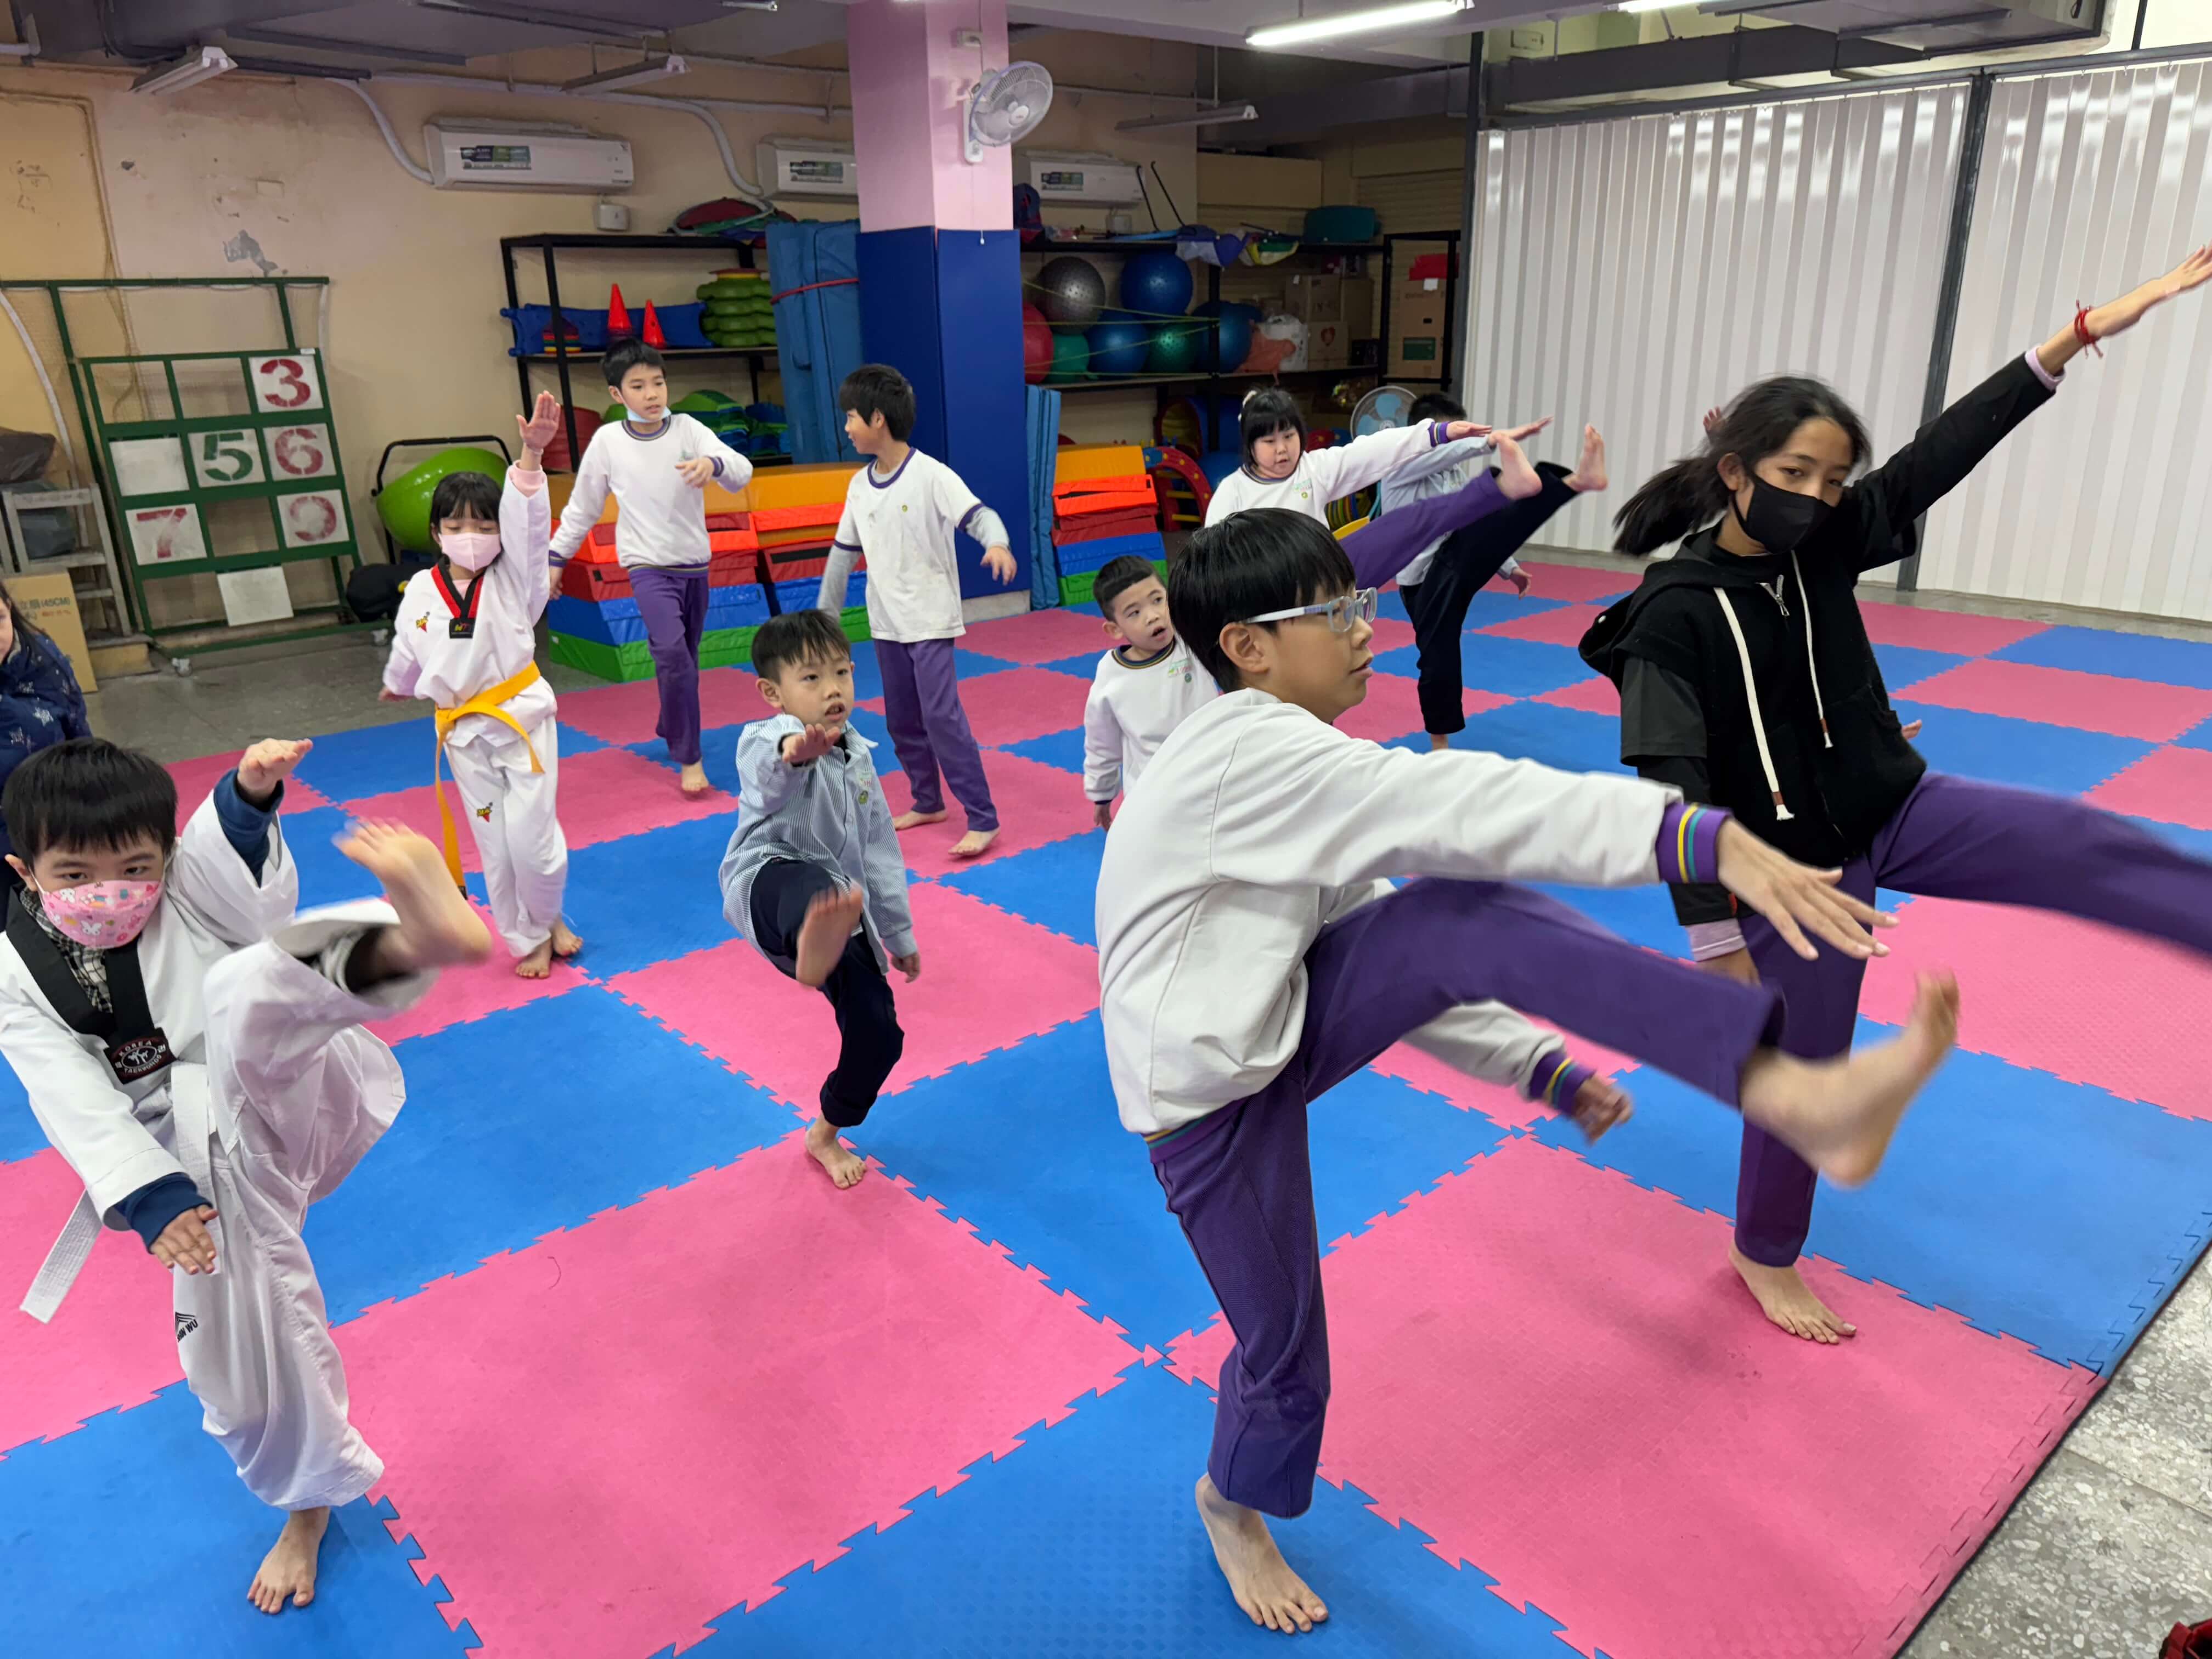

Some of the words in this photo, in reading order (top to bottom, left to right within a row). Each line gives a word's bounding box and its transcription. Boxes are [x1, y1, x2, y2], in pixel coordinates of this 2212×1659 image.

[260, 359, 311, 407] 3
[204, 432, 253, 481] 5
[275, 428, 323, 475] 6
[136, 508, 187, 558] 7
[119, 1040, 152, 1057] KOREA
[124, 1054, 162, 1074] TAEKWONDO
